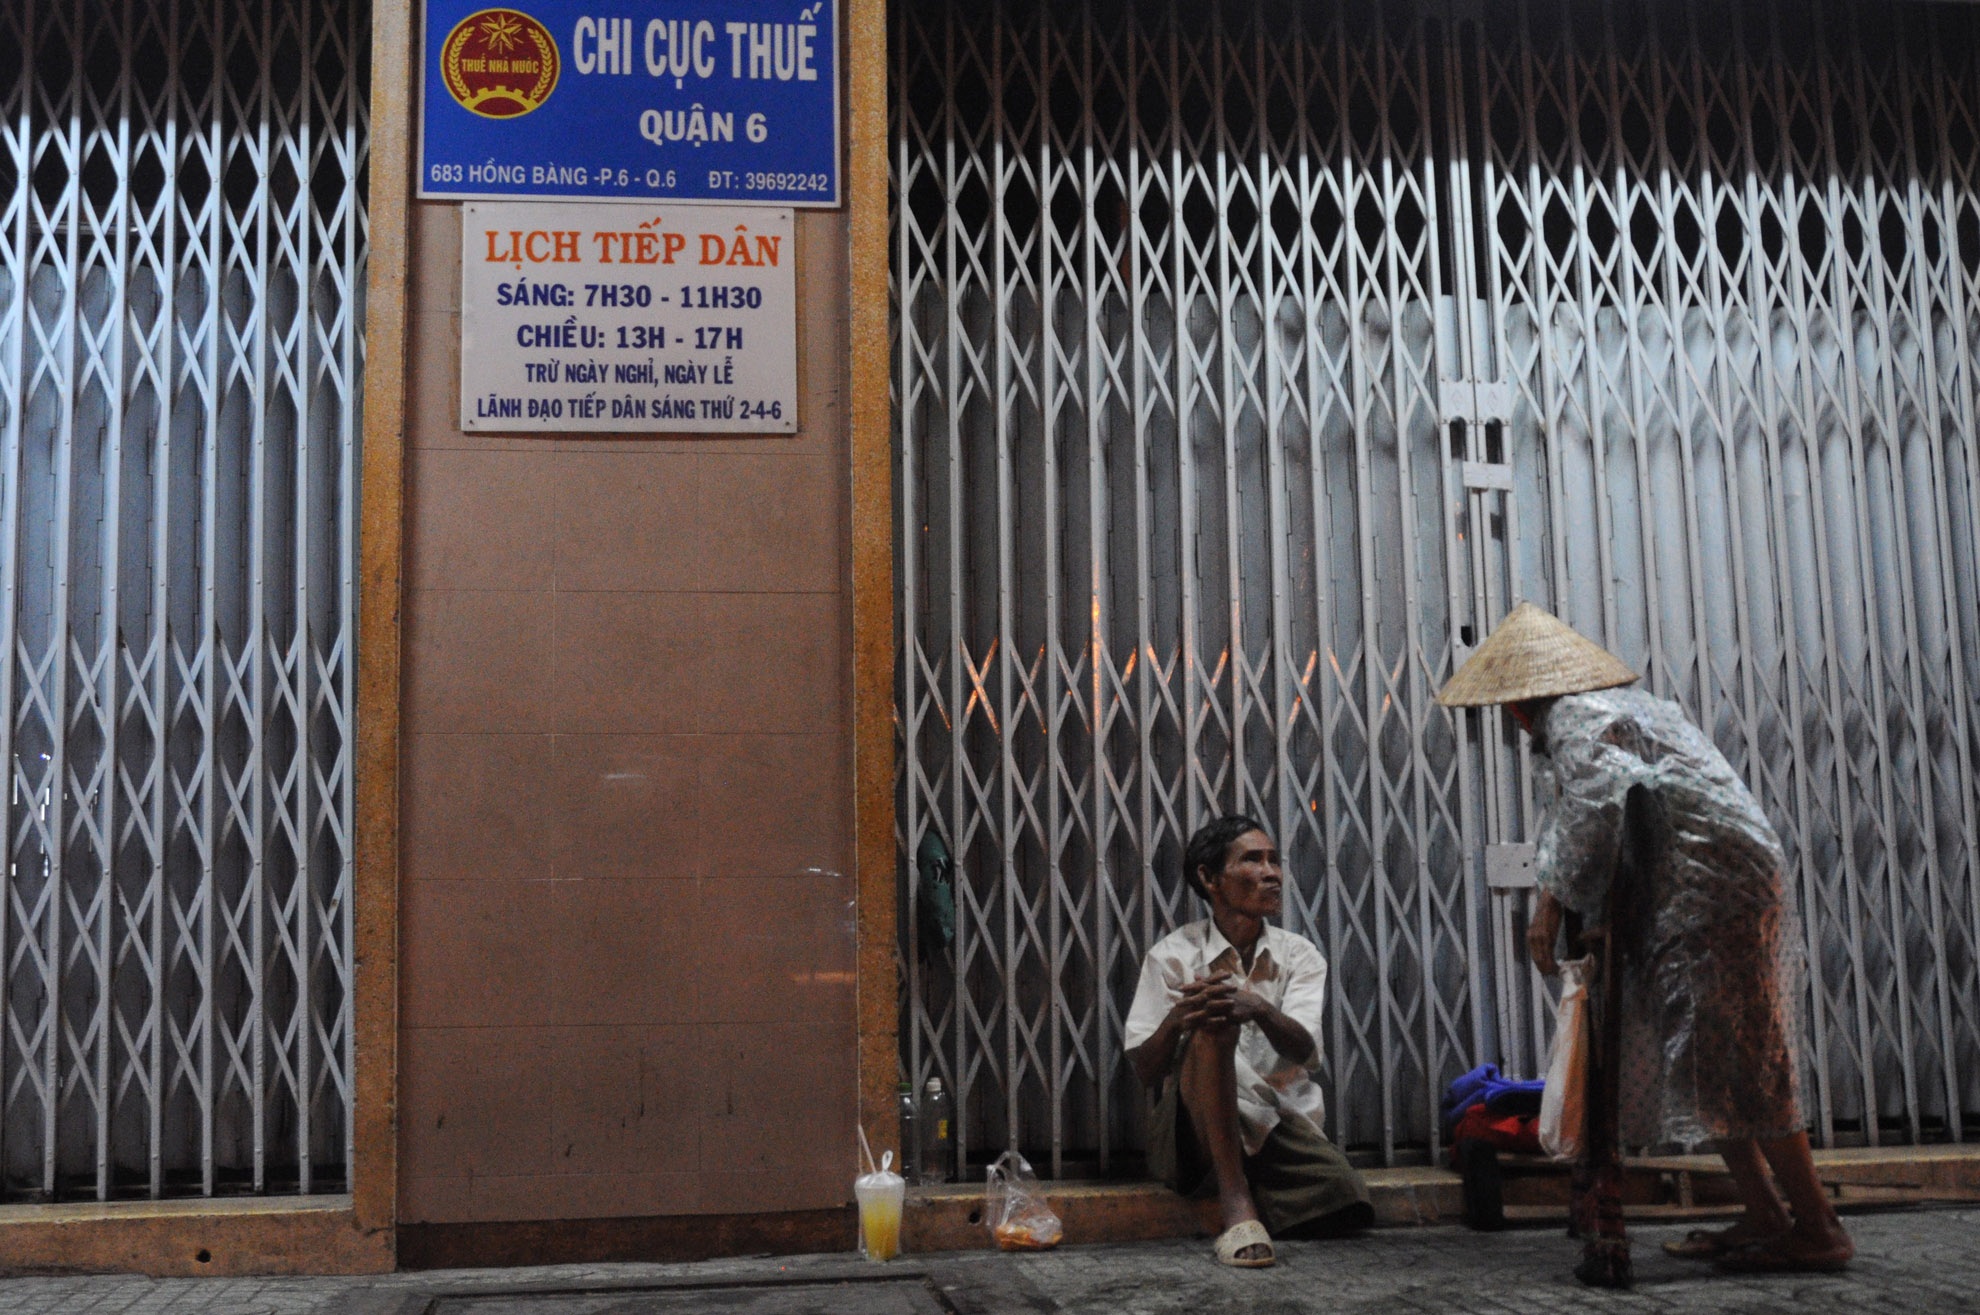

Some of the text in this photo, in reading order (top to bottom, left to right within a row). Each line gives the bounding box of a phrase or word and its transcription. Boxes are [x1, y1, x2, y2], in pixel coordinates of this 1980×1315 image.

[573, 2, 823, 90] CHI CỤC THUẾ
[461, 53, 486, 73] THUẾ
[489, 56, 509, 74] NHÀ
[639, 103, 768, 148] QUẬN 6
[431, 164, 463, 182] 683
[468, 157, 526, 184] HỒNG
[532, 162, 588, 185] BÀNG
[646, 169, 676, 188] Q.6
[708, 171, 828, 191] ĐT: 39692242
[485, 217, 782, 271] LỊCH TIẾP DÂN
[497, 276, 574, 307] SÁNG:
[584, 284, 652, 308] 7H30
[681, 286, 762, 309] 11H30
[517, 315, 605, 348] CHIỀU:
[616, 326, 665, 349] 13H
[694, 327, 743, 350] 17H
[525, 355, 734, 388] TRỪ NGÀY NGHỈ, NGÀY LỄ
[477, 391, 782, 422] LÃNH ĐẠO TIẾP DÂN SÁNG THỨ 2-4-6
